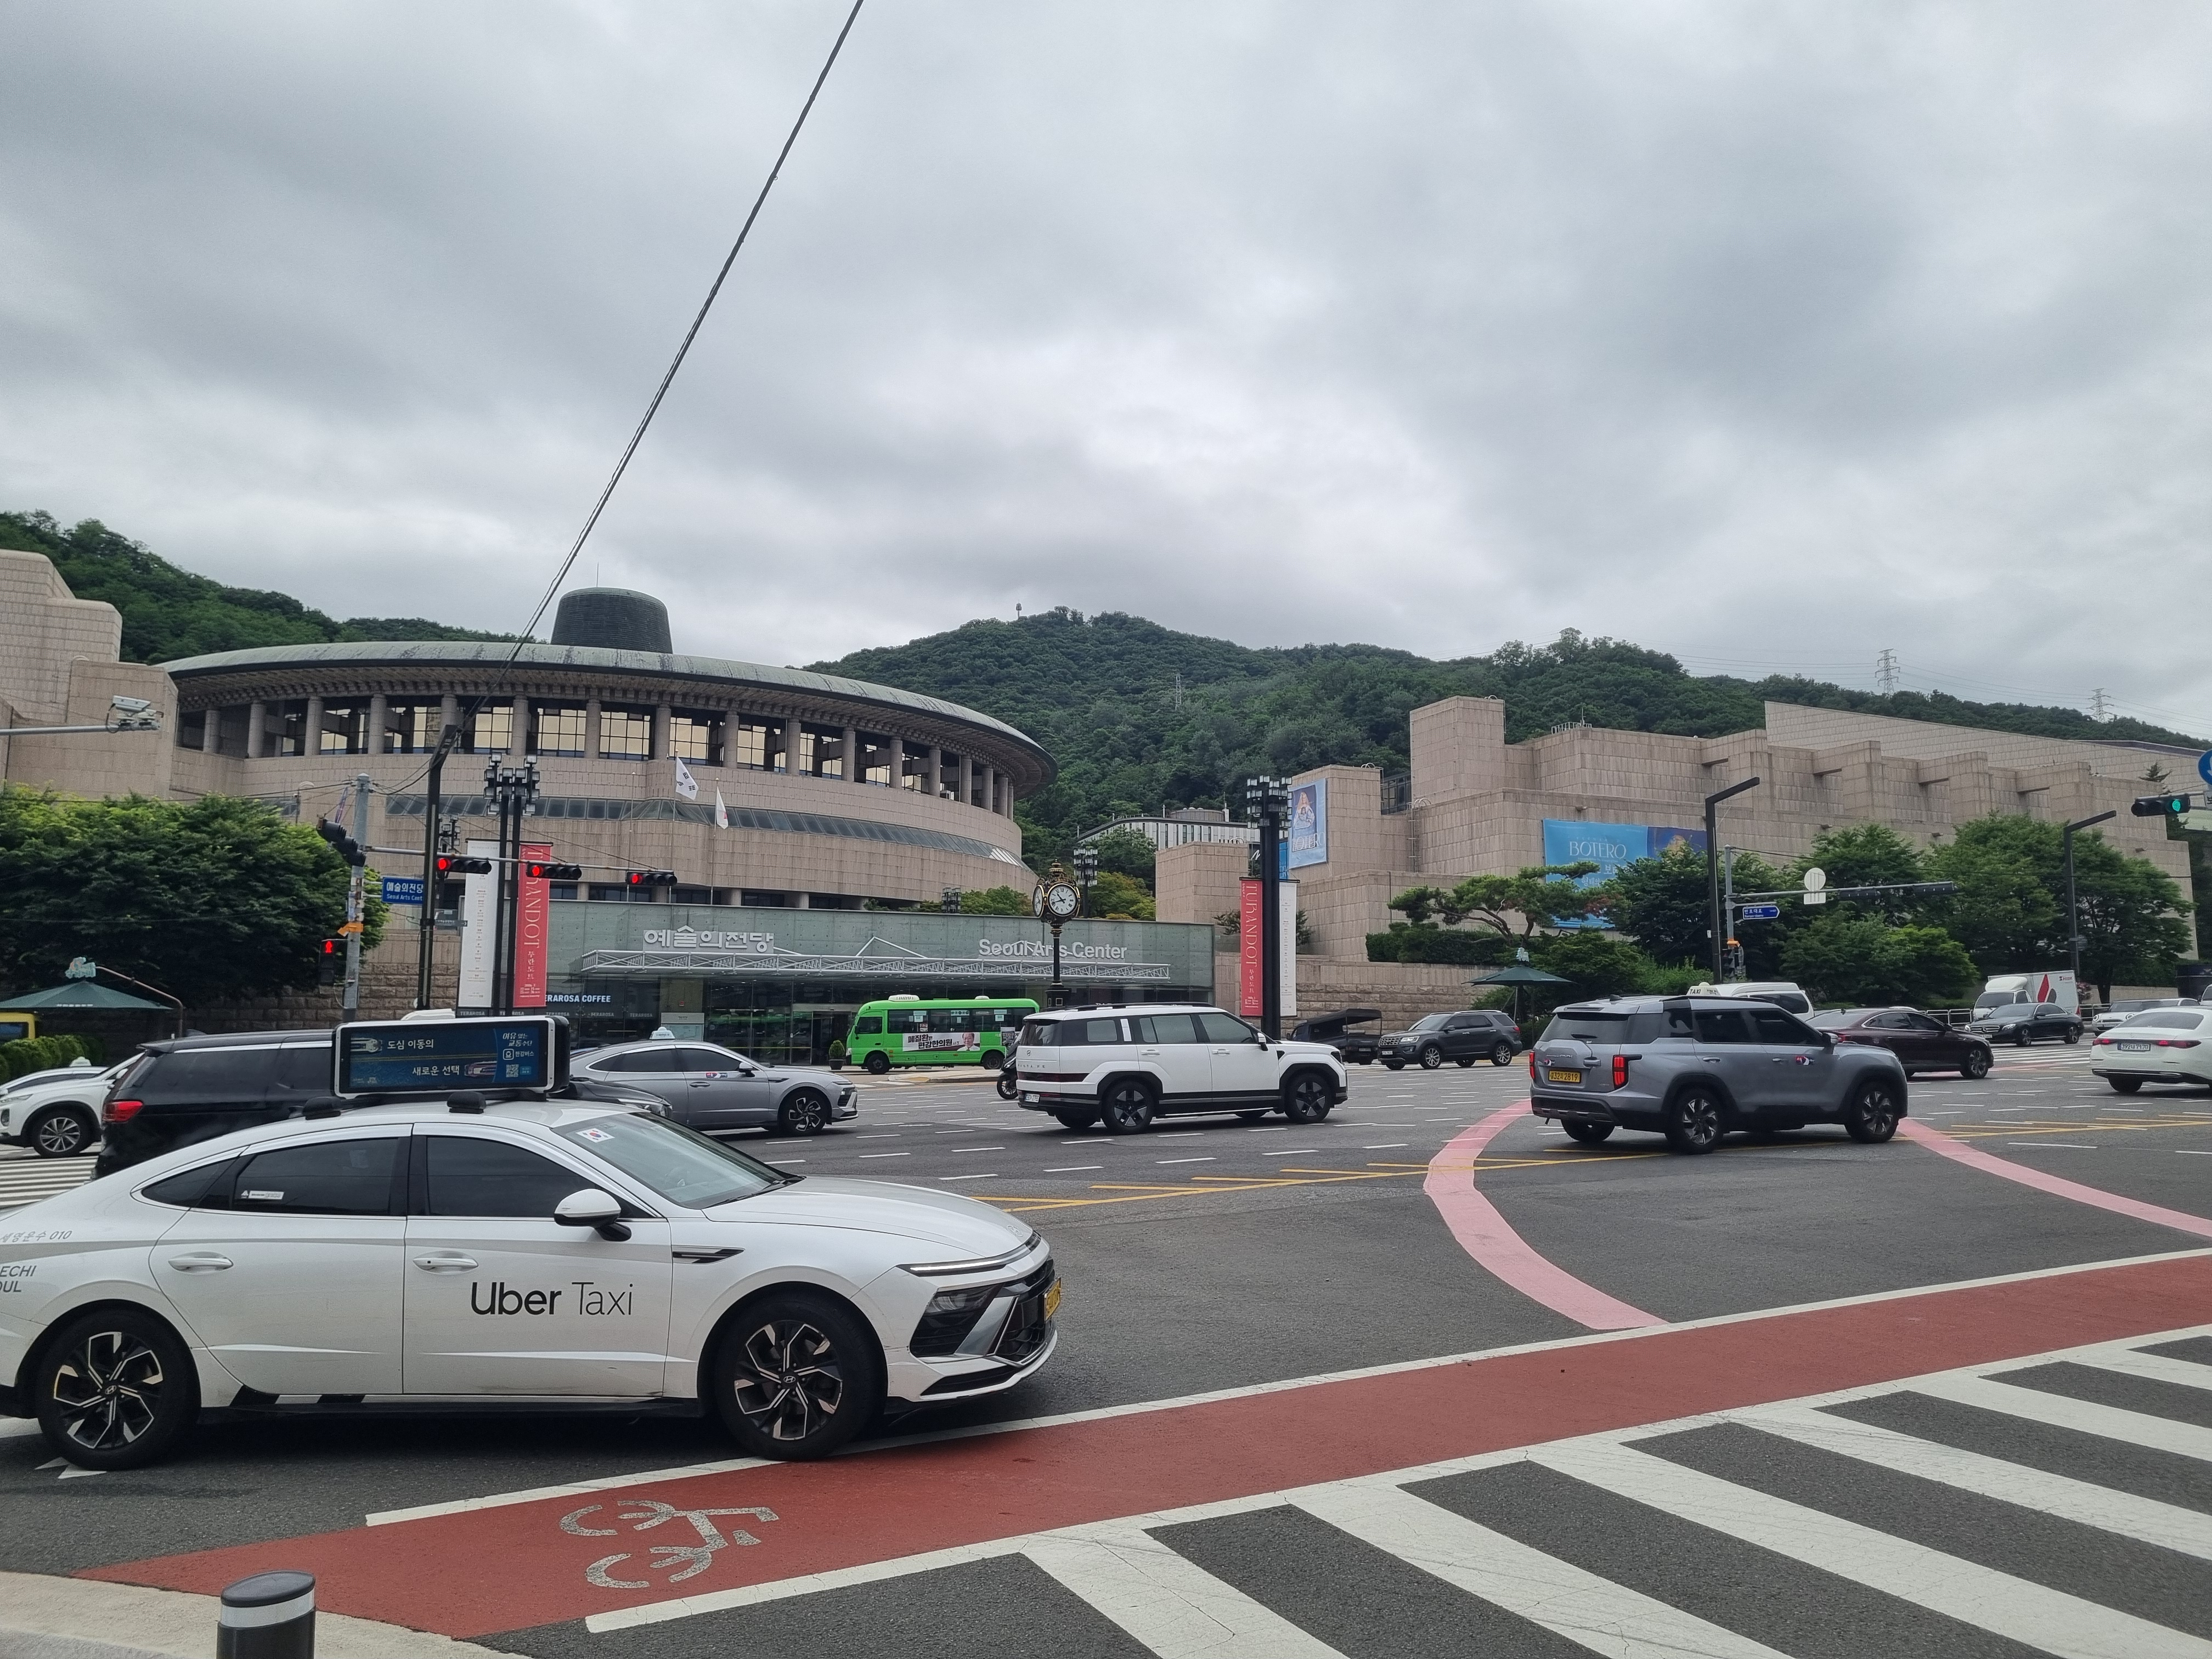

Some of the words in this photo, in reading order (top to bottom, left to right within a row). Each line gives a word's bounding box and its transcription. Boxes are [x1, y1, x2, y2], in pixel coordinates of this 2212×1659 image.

[1570, 841, 1627, 859] BOTERO
[386, 882, 424, 894] 예술의전당
[1245, 883, 1257, 968] TURANDOT
[644, 924, 774, 952] 예술의전당
[979, 939, 1028, 956] Seoul
[1032, 940, 1068, 958] Ars
[1072, 941, 1127, 959] Center
[544, 994, 580, 1002] ERAROSA
[502, 1032, 517, 1040] 여유
[387, 1040, 405, 1051] 도심
[408, 1039, 435, 1049] 이동의
[918, 1039, 952, 1049] 편강한의원
[412, 1066, 439, 1076] 새로운
[442, 1065, 460, 1076] 선택
[49, 1230, 72, 1240] 010
[0, 1280, 22, 1293] UL
[471, 1282, 562, 1316] Uber
[572, 1282, 634, 1316] Taxi
